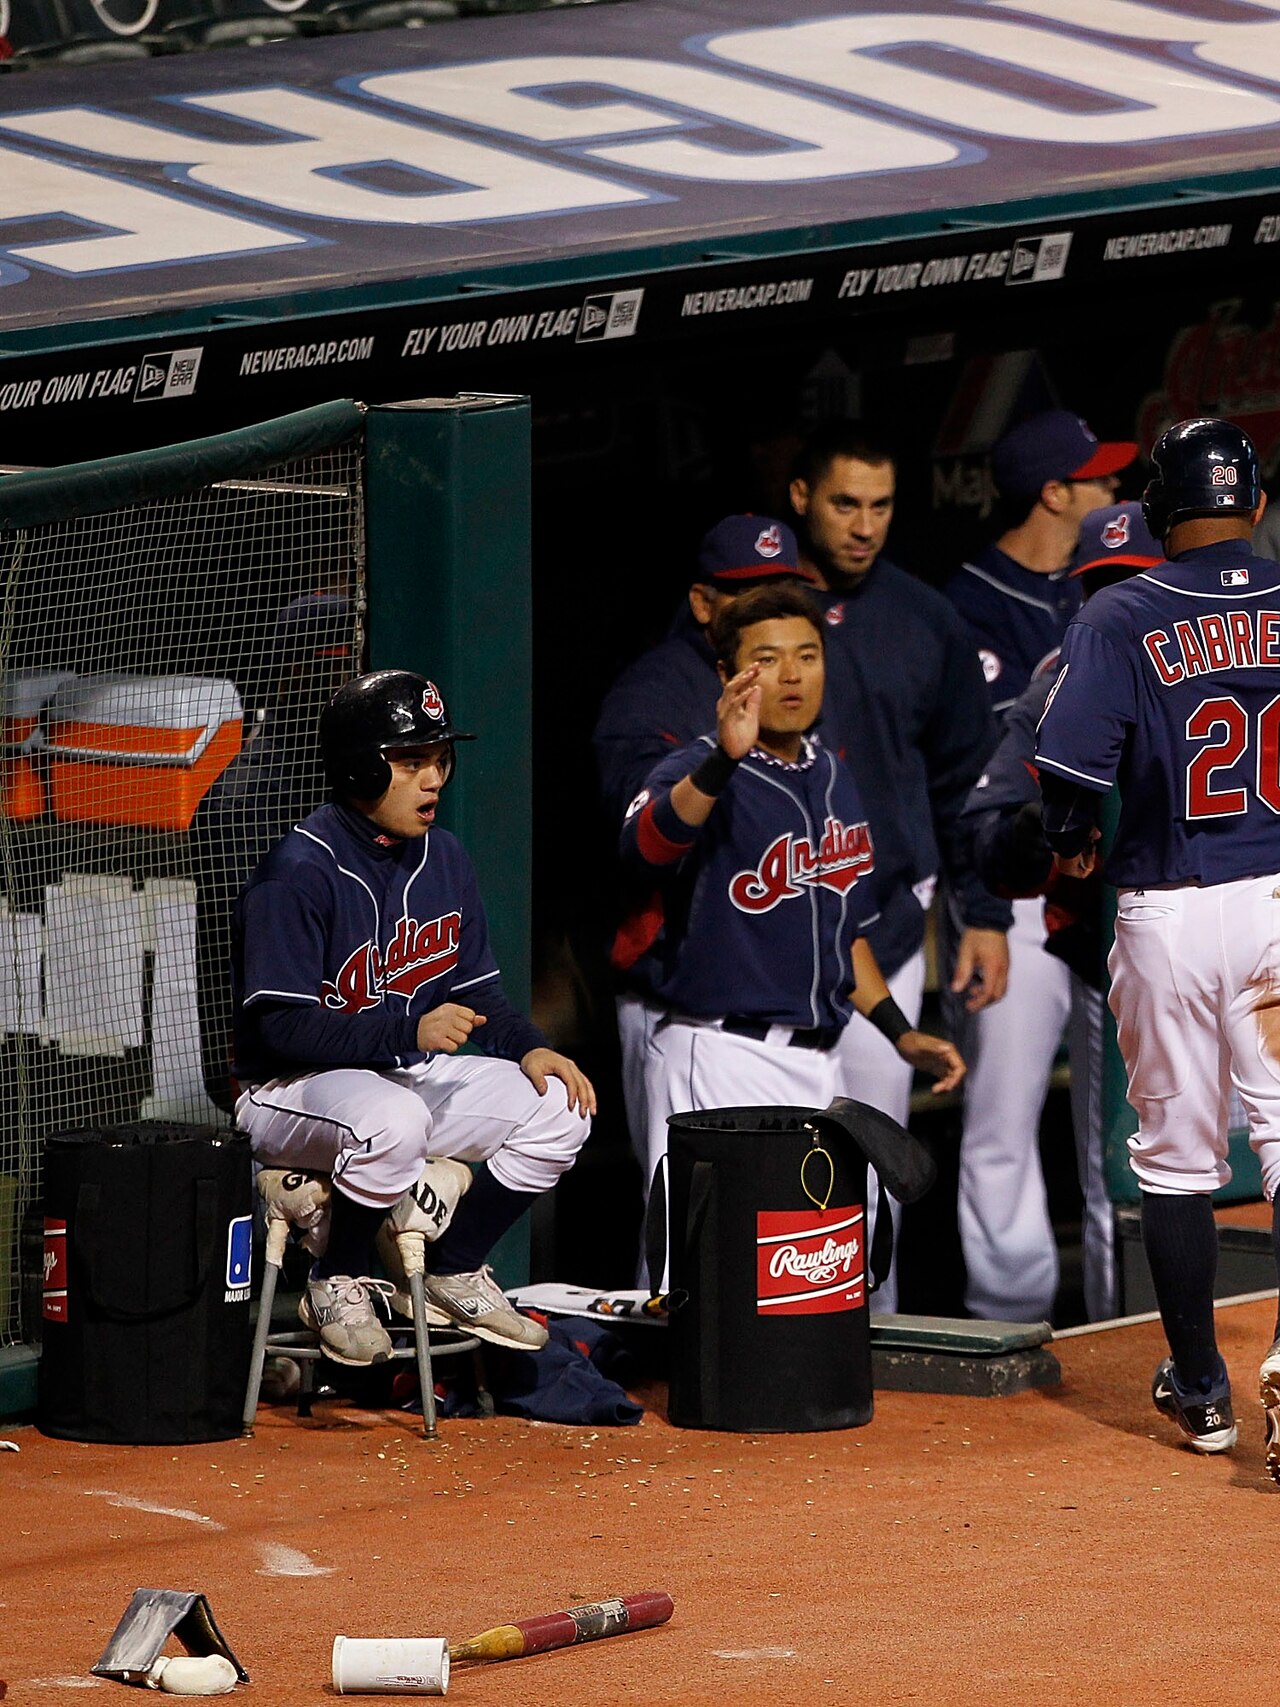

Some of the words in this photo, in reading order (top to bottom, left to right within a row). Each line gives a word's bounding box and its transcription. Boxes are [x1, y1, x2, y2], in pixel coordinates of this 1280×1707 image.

[838, 270, 870, 298] FLY
[873, 262, 922, 294] YOUR
[919, 256, 968, 288] OWN
[964, 249, 1011, 282] FLAG
[681, 278, 814, 317] NEWERACAP.COM
[401, 329, 434, 357] FLY
[437, 322, 487, 353] YOUR
[486, 316, 535, 347] OWN
[532, 307, 580, 340] FLAG
[173, 358, 197, 373] NEW
[239, 336, 375, 376] NEWERACAP.COM
[42, 372, 90, 405] OWN
[88, 366, 137, 398] FLAG
[170, 372, 193, 387] ERA
[1212, 465, 1238, 486] 20
[769, 1238, 859, 1278] Rawlings
[224, 1289, 244, 1303] MAJOR
[1205, 1413, 1221, 1428] 20
